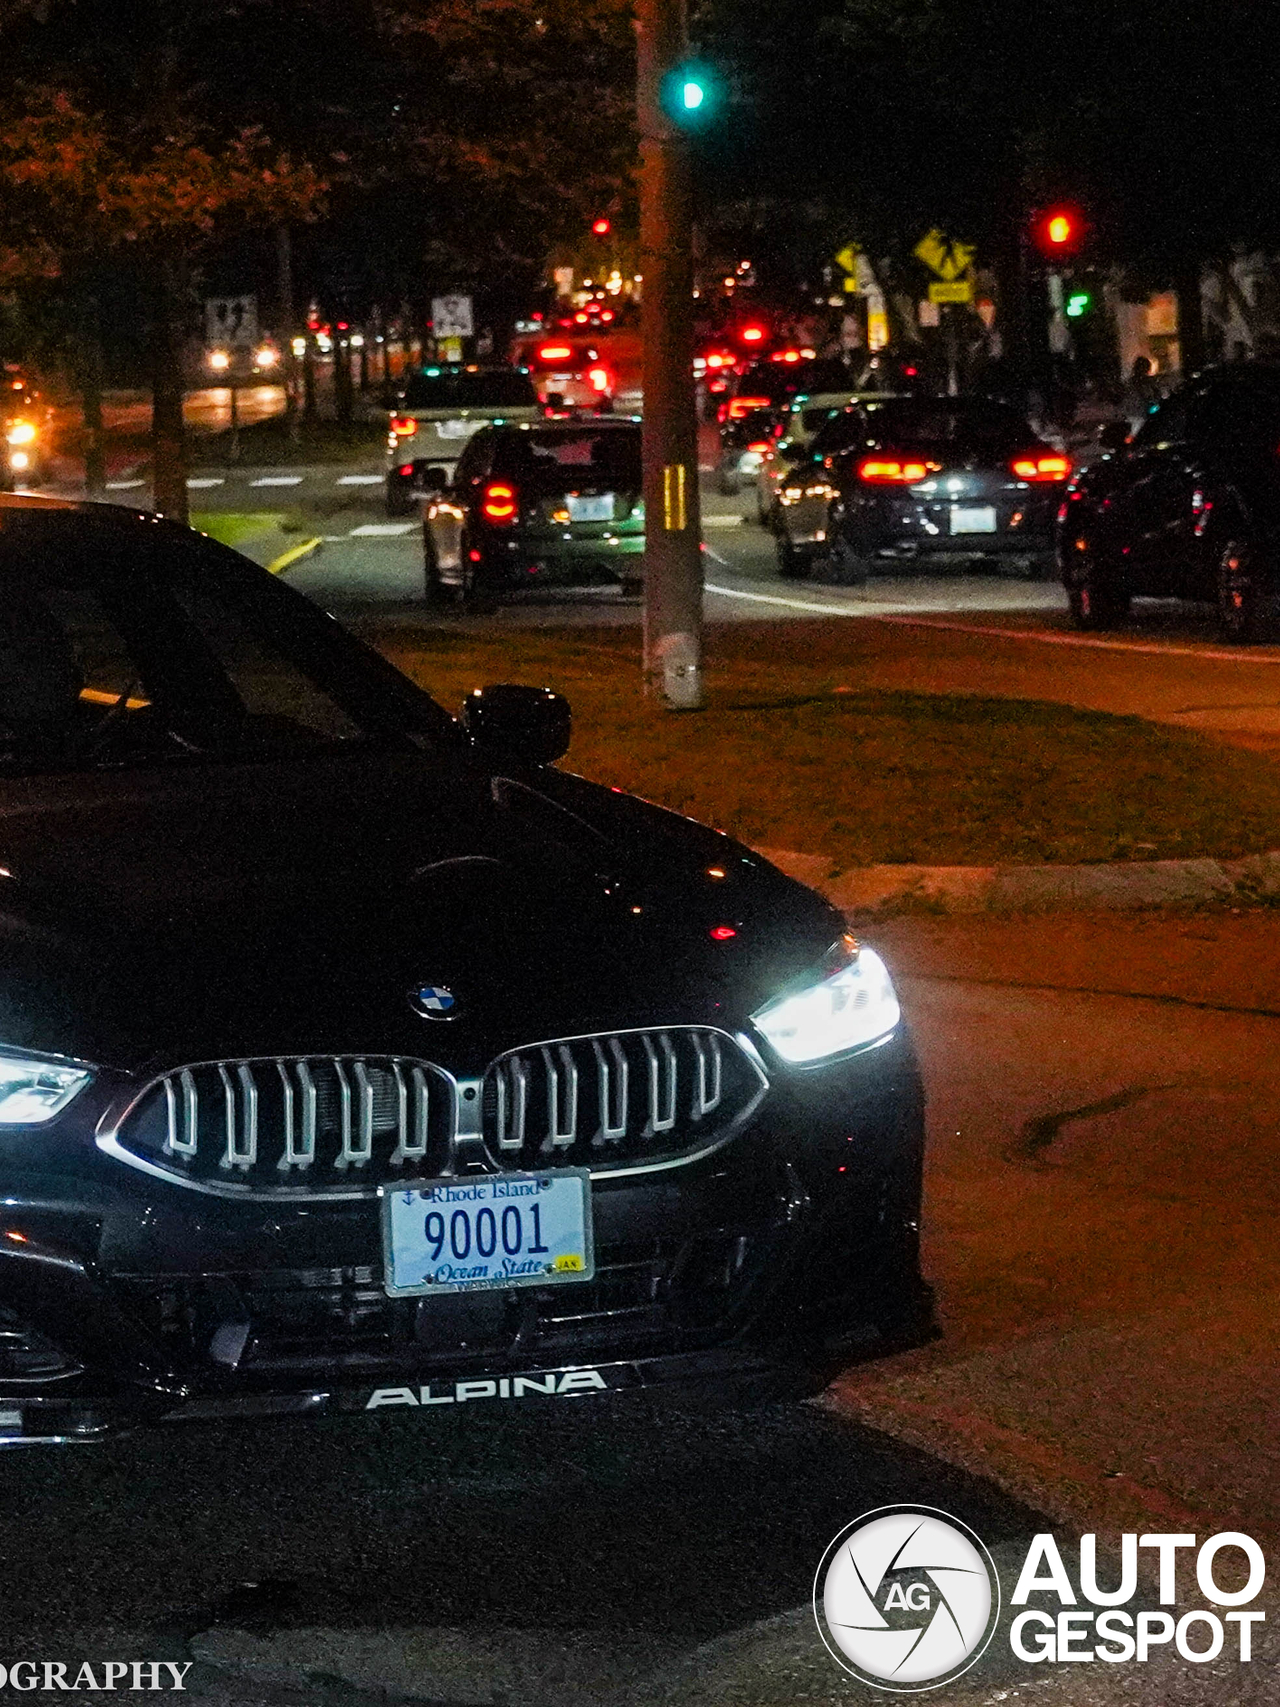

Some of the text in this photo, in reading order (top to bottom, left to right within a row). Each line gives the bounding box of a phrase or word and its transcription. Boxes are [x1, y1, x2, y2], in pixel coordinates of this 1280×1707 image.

[431, 1179, 540, 1203] Rhode Island
[425, 1202, 549, 1261] 90001
[435, 1257, 542, 1284] Ocean State
[365, 1370, 608, 1410] ALPINA
